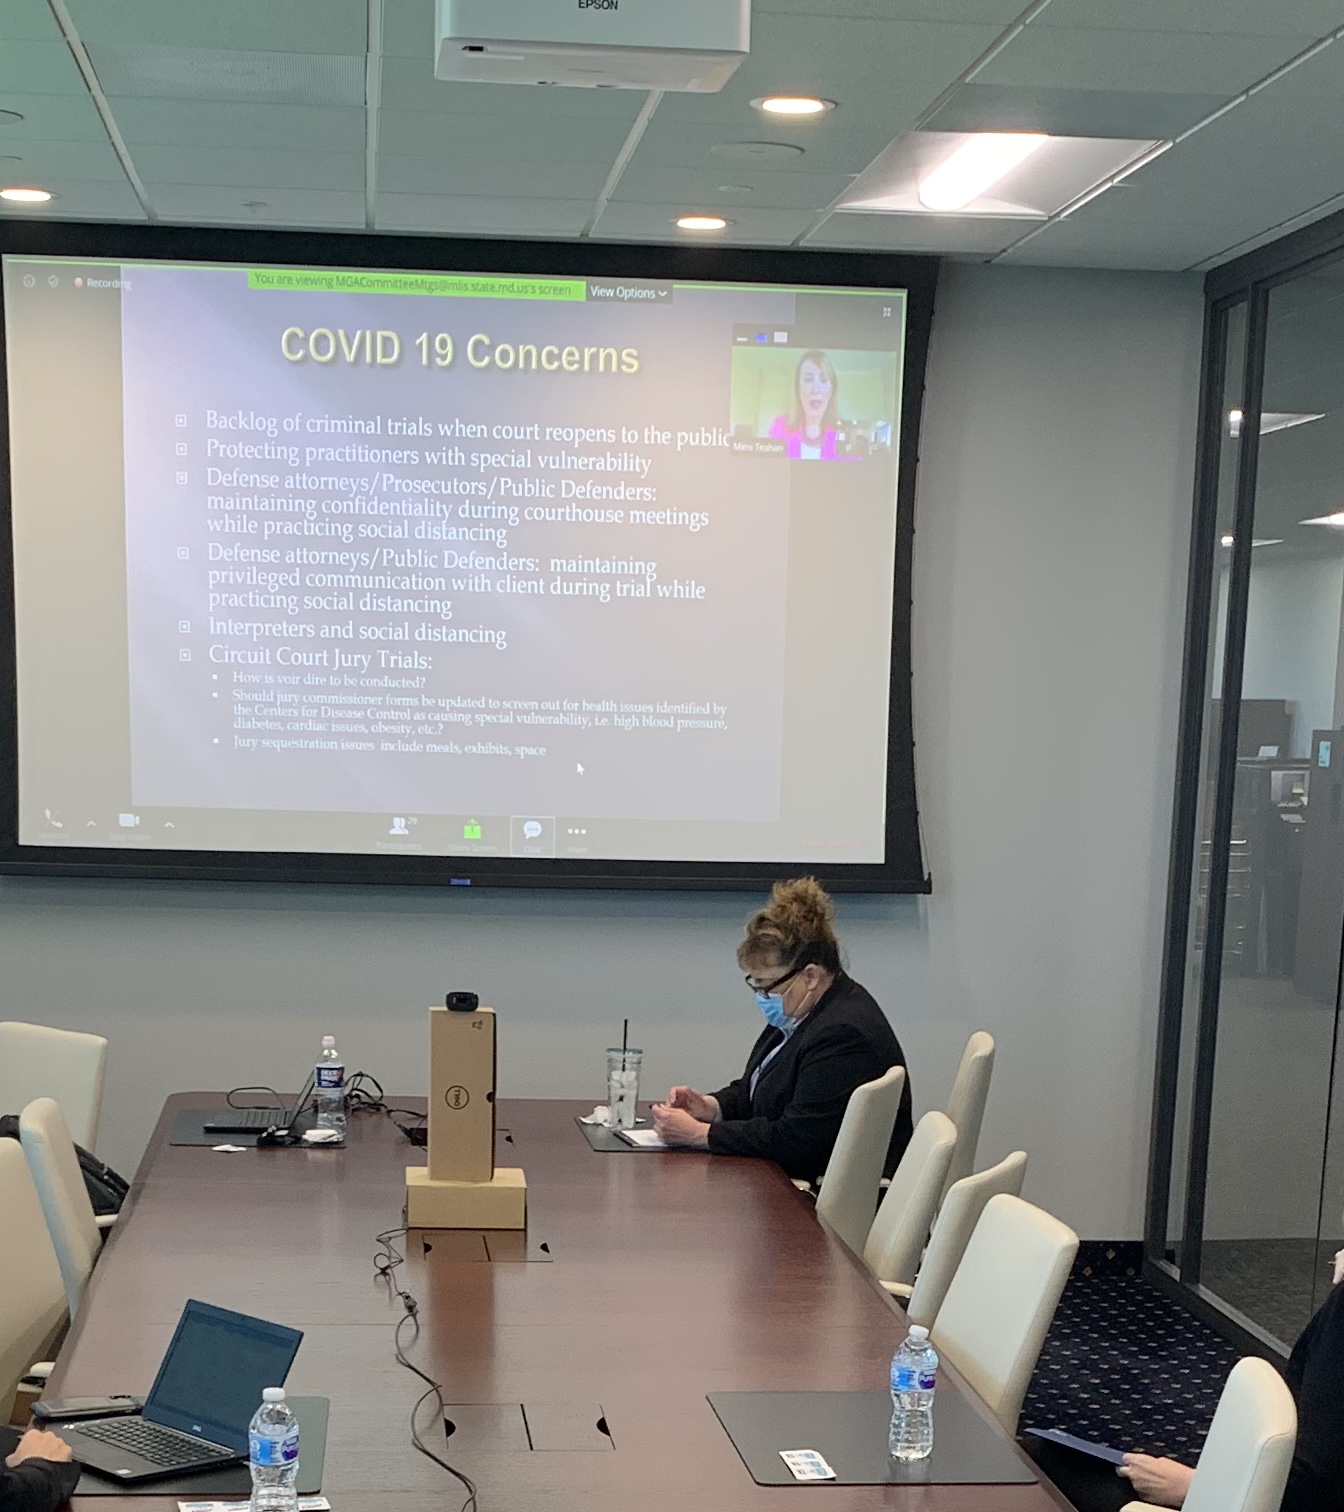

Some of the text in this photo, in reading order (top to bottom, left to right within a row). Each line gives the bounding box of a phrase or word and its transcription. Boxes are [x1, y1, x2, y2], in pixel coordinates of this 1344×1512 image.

[578, 0, 619, 10] EPSON
[87, 277, 132, 291] Recording
[254, 271, 272, 283] You
[276, 275, 293, 284] are
[296, 273, 333, 287] viewing
[538, 286, 572, 295] screen
[590, 285, 655, 301] View Options
[280, 325, 639, 372] COVID 19 Concerns
[205, 409, 730, 453] Backlog of criminal trials when court reopens to the public
[206, 438, 652, 478] Protecting practitioners with special vulnerability
[206, 467, 657, 504] Defense attorneys/Prosecutors/Public Defenders:
[207, 491, 709, 531] maintaining confidentiality during courthouse meetings
[207, 514, 507, 548] while practicing social distancing
[207, 542, 657, 581] Defense attorneys/Public Defenders: maintaining
[208, 565, 705, 602] privileged communication with client during trial while
[209, 588, 451, 619] practicing social distancing
[208, 616, 507, 649] Interpreters and social distancing
[208, 645, 432, 673] Circuit Court Jury Trials:
[232, 671, 426, 688] How is voir dire to be conducted?
[231, 690, 728, 718] Should jury commissioner forms be updated to screen out for health issues identified by
[232, 704, 252, 715] the
[254, 704, 299, 716] Centers
[300, 705, 318, 717] for
[320, 706, 365, 718] Disease
[366, 707, 410, 719] Control
[412, 712, 426, 720] as
[427, 709, 472, 725] causing
[474, 710, 514, 726] special
[515, 711, 592, 728] vulnerability,
[613, 714, 640, 729] high
[641, 715, 674, 727] blood
[676, 719, 728, 732] pressure,
[232, 717, 284, 731] diabetes,
[286, 719, 329, 731] cardiac
[331, 720, 368, 733] issues,
[370, 721, 415, 737] obesity,
[233, 736, 546, 758] Jury sequestration issues include meals, exhibits, space
